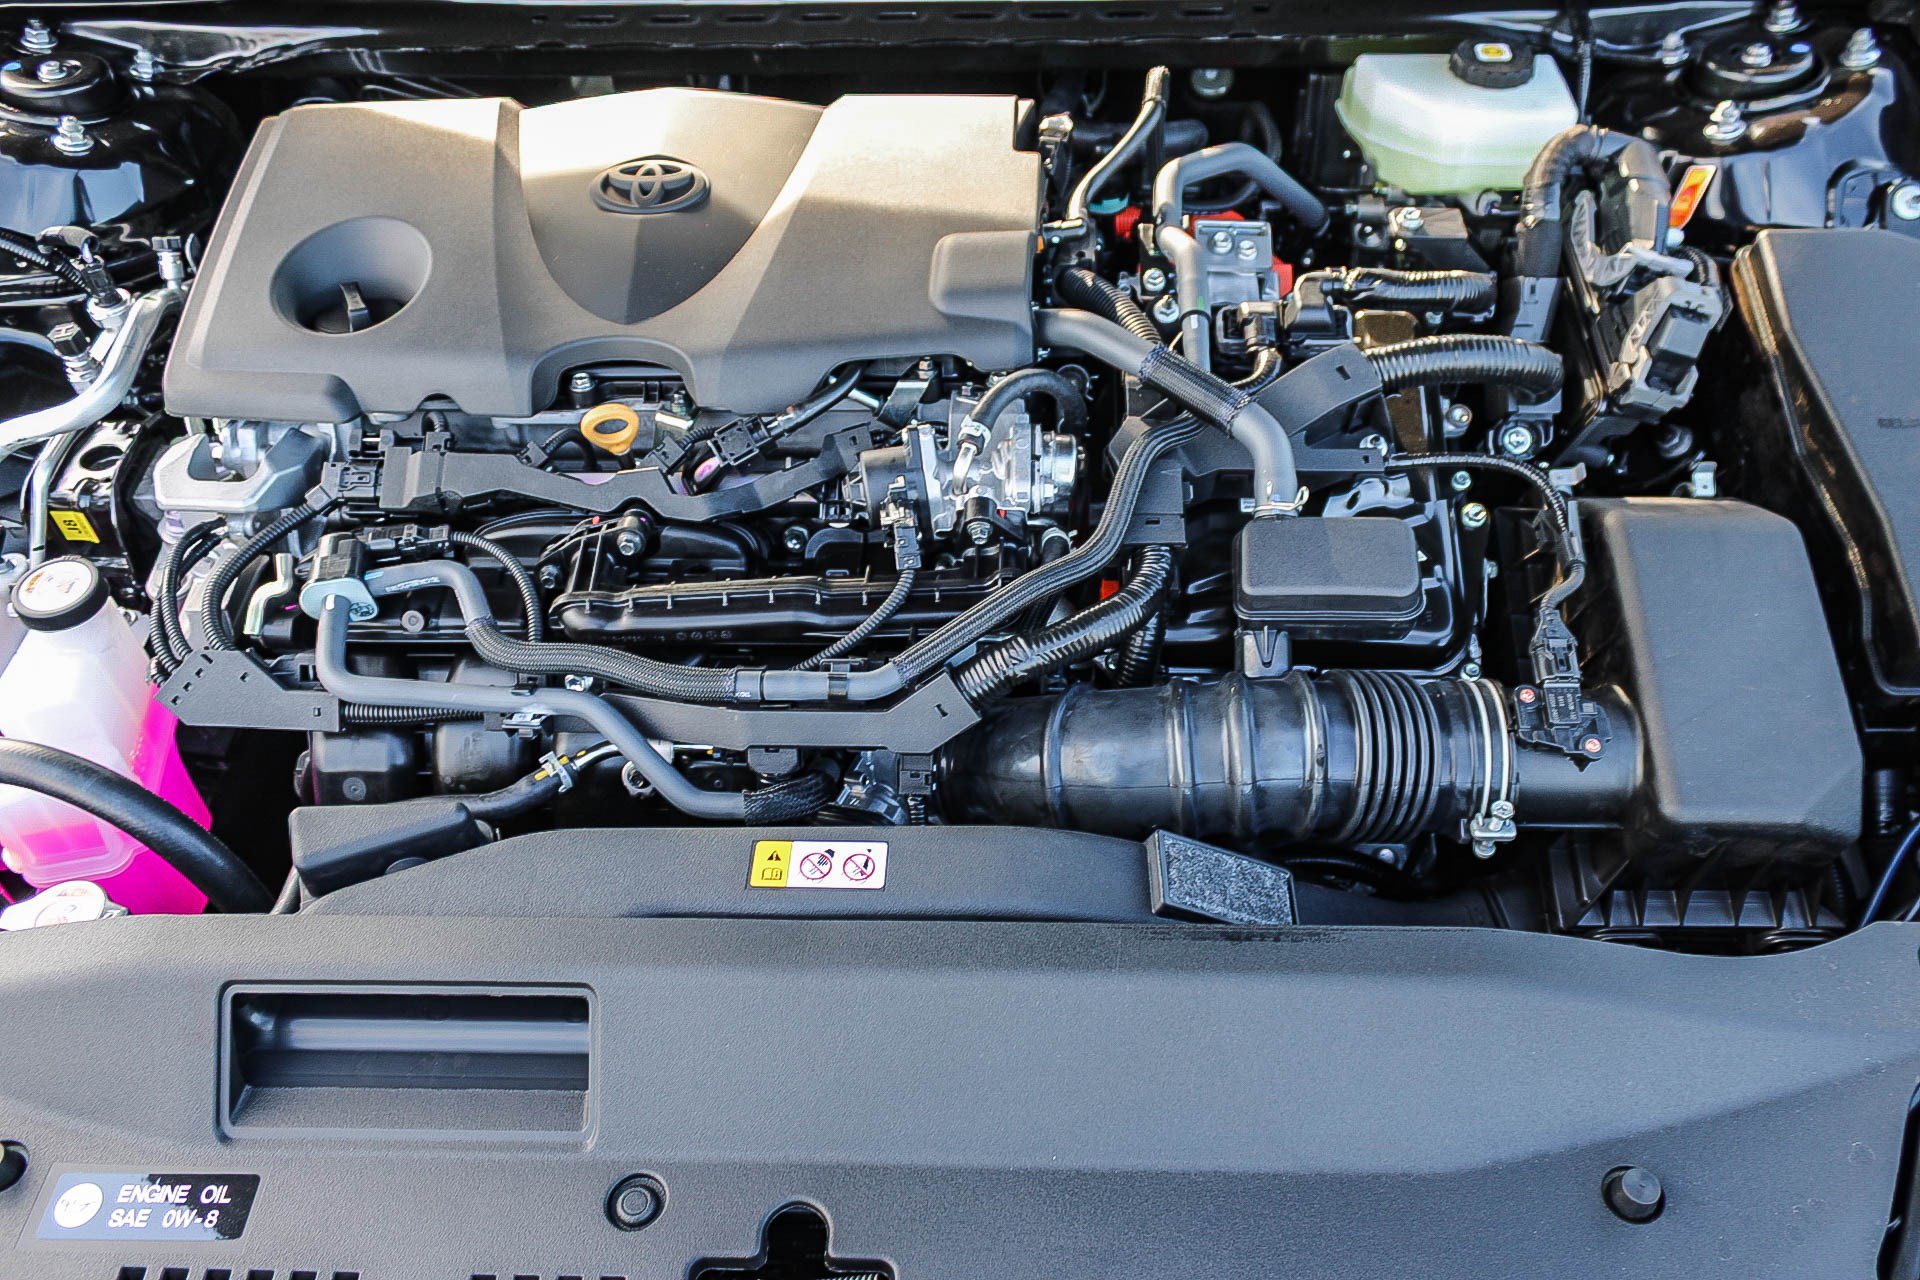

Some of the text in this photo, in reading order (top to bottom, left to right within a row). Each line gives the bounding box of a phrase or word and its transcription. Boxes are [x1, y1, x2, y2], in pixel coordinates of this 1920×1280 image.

[117, 1184, 232, 1204] ENGINE OIL
[107, 1208, 219, 1229] SAE 0W-8
